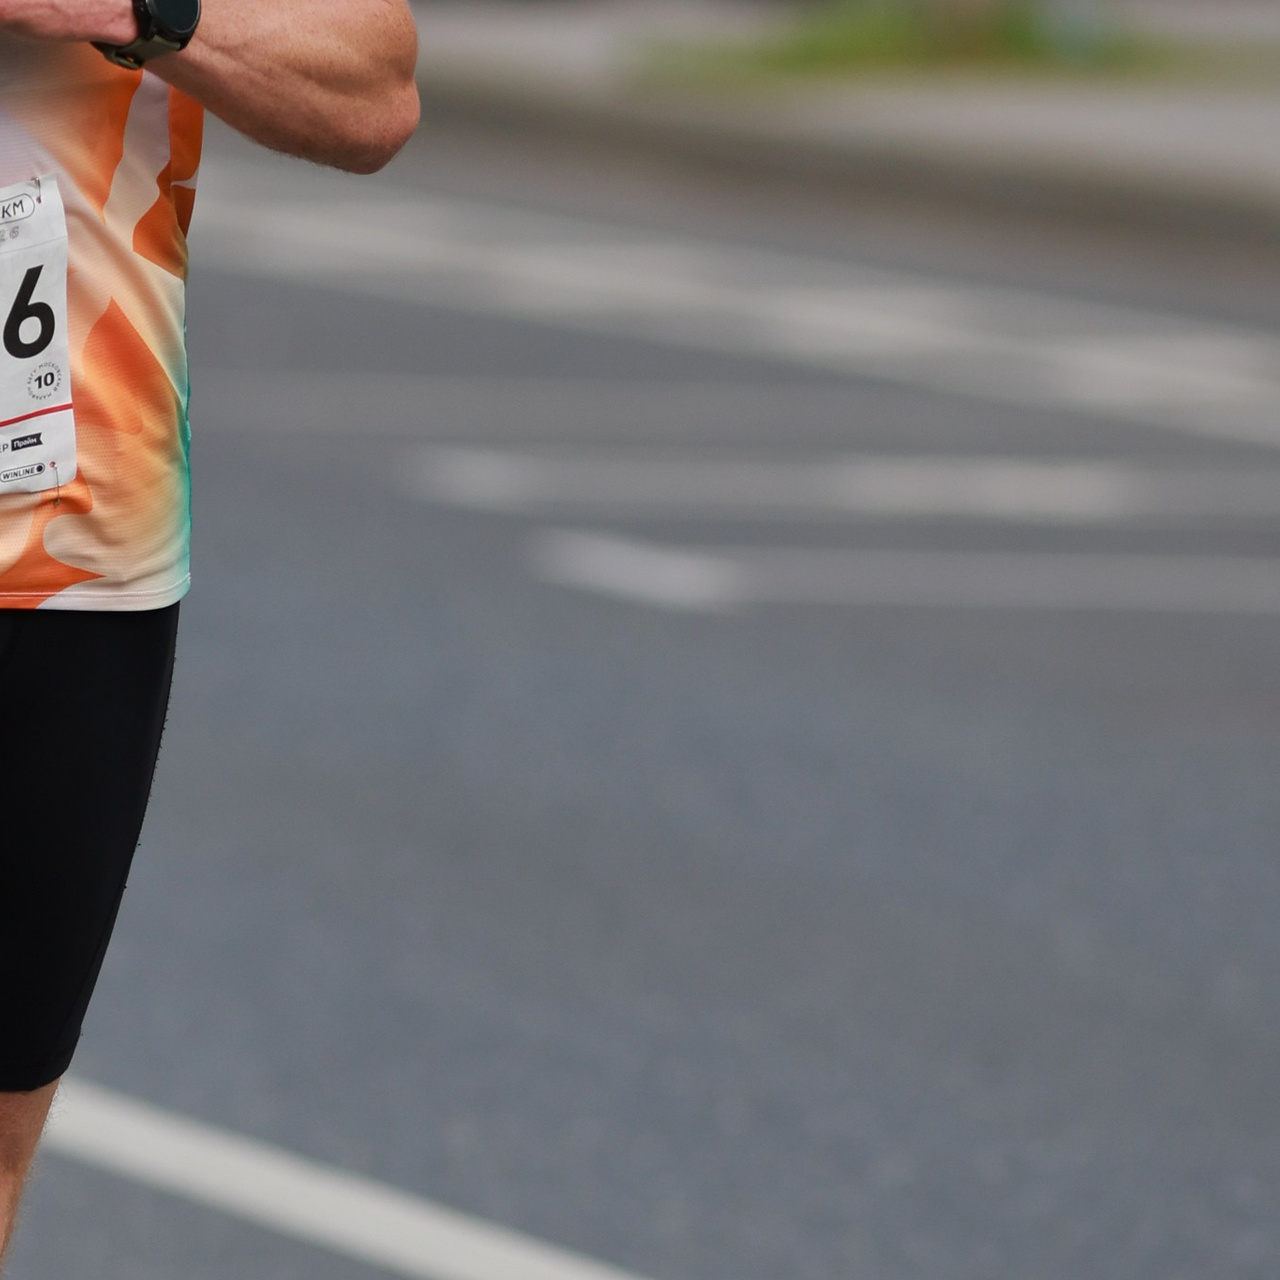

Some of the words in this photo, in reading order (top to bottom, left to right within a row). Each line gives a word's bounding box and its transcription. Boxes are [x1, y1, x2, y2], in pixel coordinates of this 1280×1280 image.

[1, 200, 25, 220] КМ
[34, 371, 55, 389] 10
[2, 467, 36, 480] WINLINE
